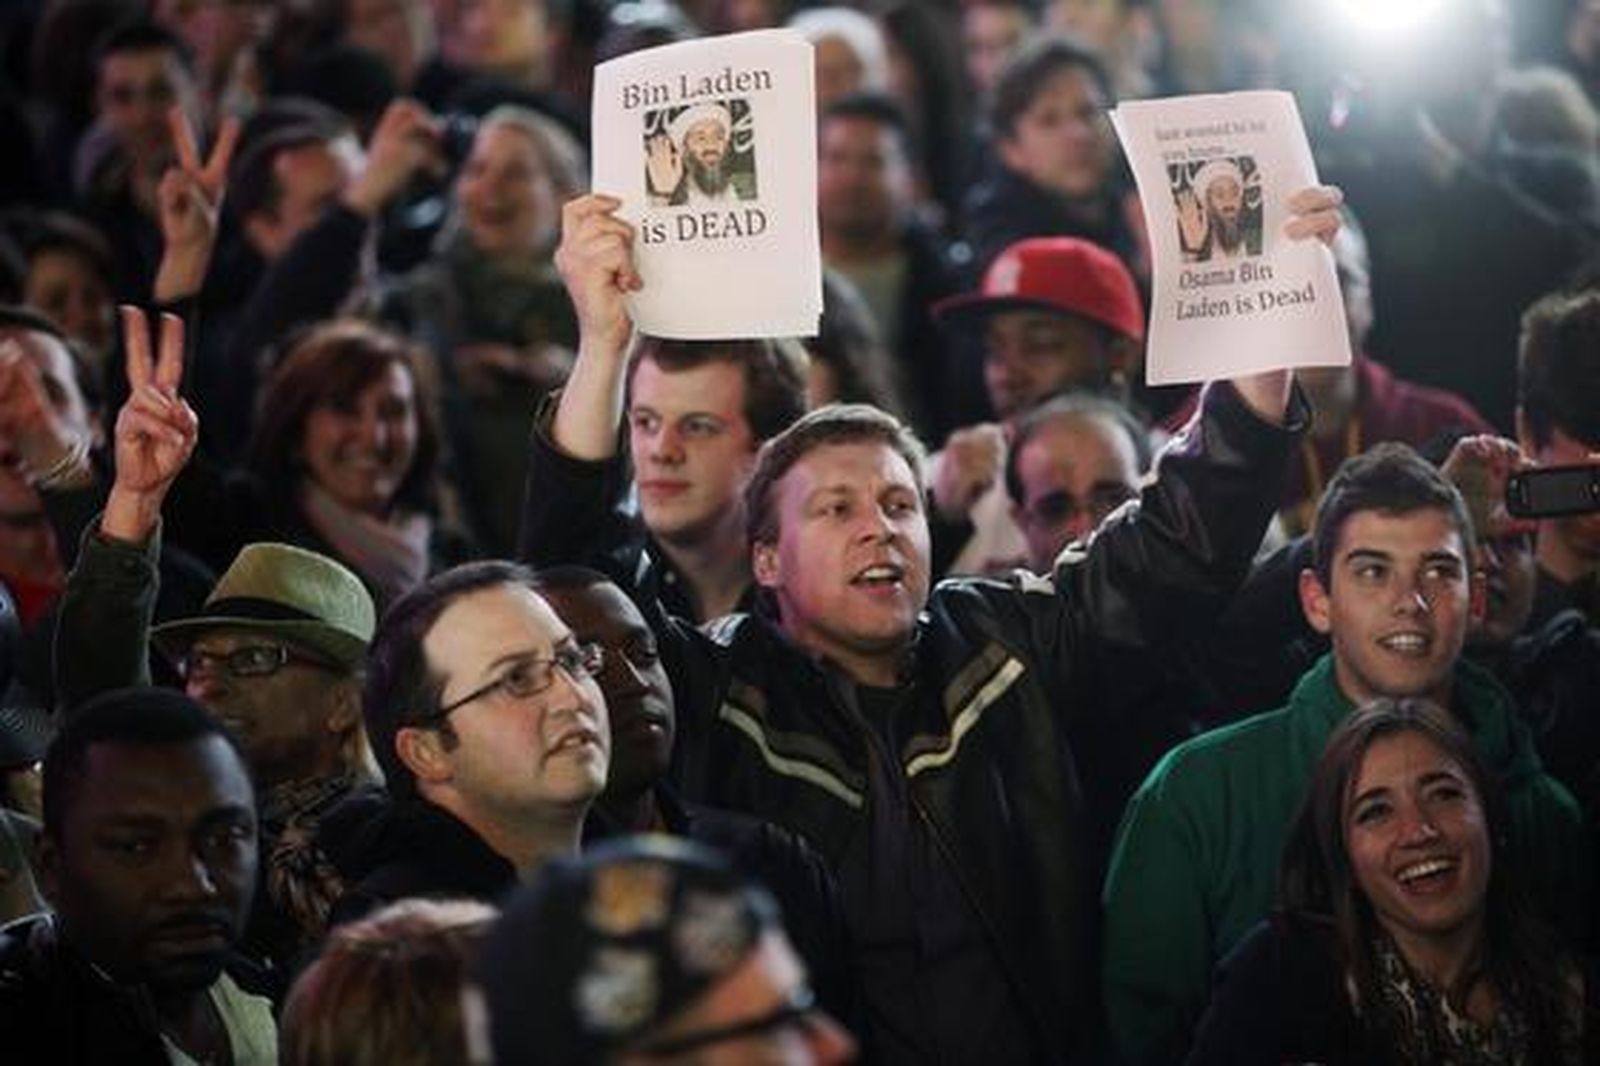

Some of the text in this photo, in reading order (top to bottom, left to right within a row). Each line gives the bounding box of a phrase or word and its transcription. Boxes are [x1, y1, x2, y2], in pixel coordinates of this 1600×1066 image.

[622, 67, 772, 109] Bin Laden
[641, 209, 767, 243] is DEAD
[1179, 262, 1273, 290] Osama Bin
[1176, 282, 1316, 320] Laden is Dead
